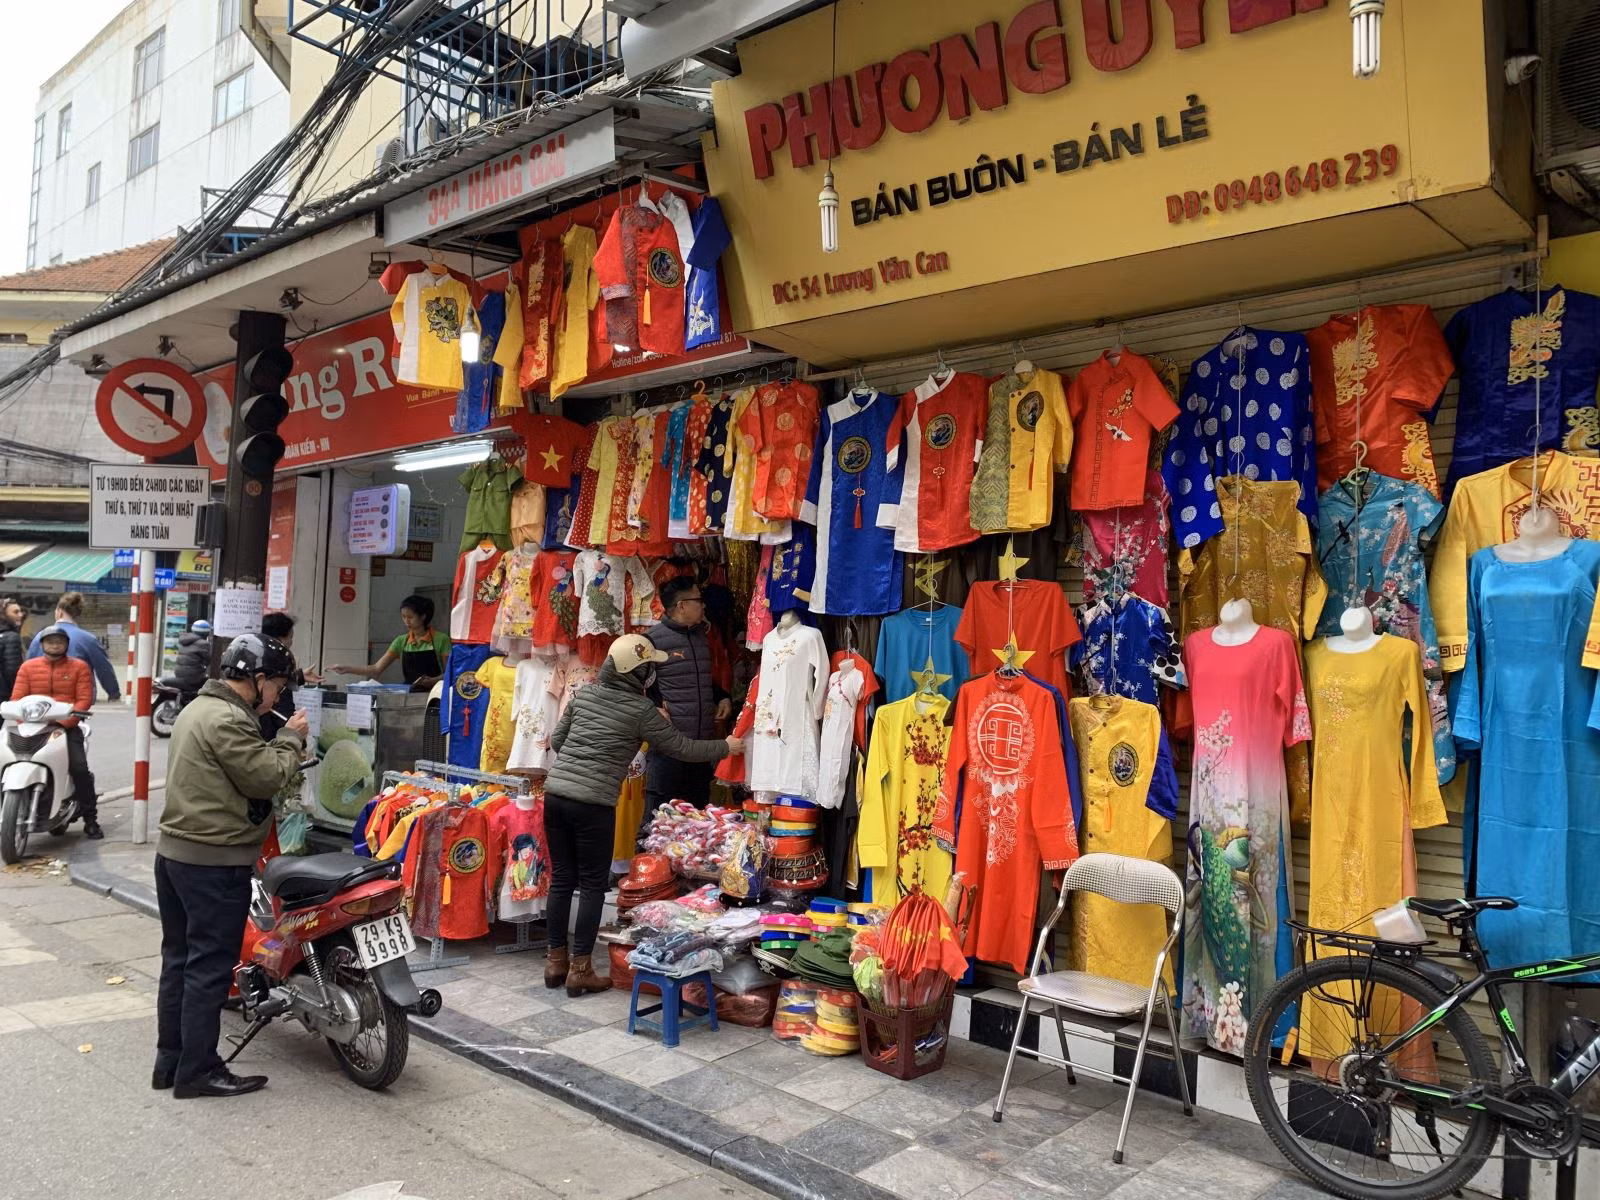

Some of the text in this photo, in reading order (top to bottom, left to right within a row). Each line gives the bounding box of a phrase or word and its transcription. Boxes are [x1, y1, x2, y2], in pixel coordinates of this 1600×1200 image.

[530, 133, 565, 188] GAI
[851, 182, 919, 227] BÁN
[927, 153, 1026, 207] BUÔN
[1052, 122, 1145, 174] BÁN
[1155, 94, 1209, 149] LẺ
[915, 250, 949, 275] Can
[107, 477, 128, 492] 19H00
[130, 474, 144, 492] ĐẾN
[145, 478, 167, 492] 24H00
[169, 475, 183, 493] CÁC
[143, 501, 148, 516] 7
[160, 497, 174, 516] CHỦ
[176, 499, 195, 519] NHẬT
[130, 521, 170, 540] HÀNG TUẦN
